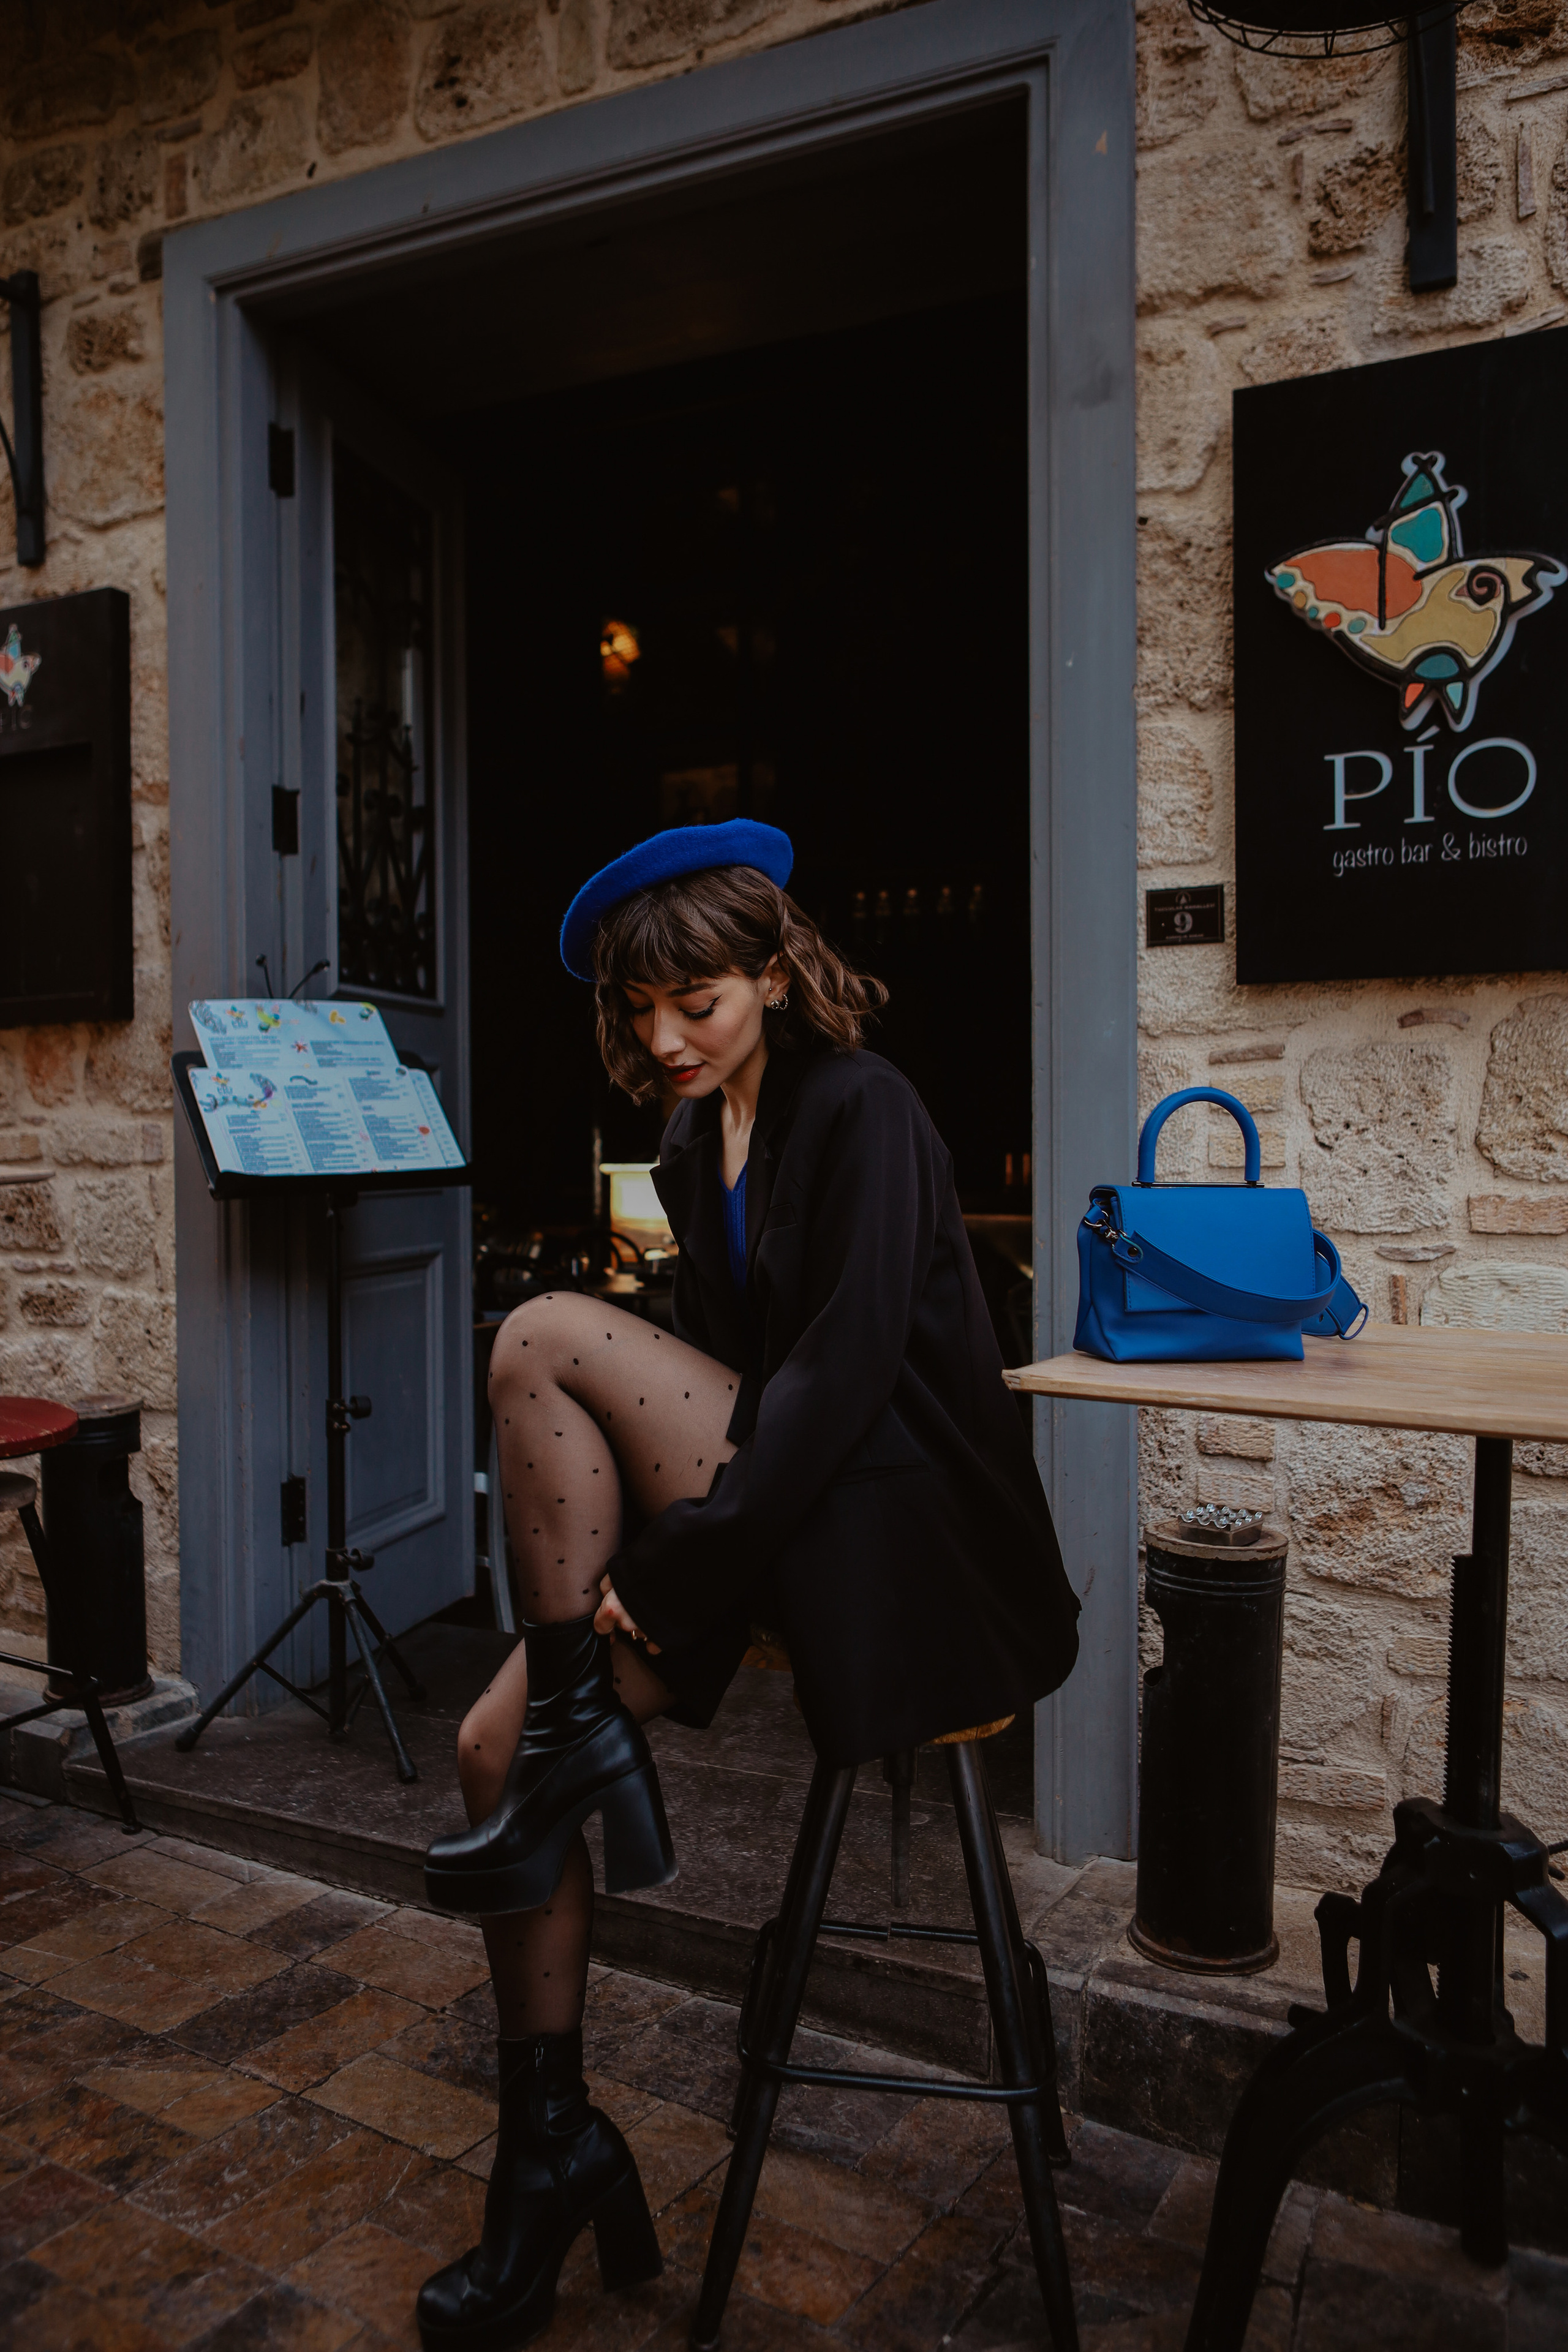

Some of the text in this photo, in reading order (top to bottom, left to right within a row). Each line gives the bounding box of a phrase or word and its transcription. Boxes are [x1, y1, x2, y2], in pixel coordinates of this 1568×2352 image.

[1324, 726, 1537, 830] PÍO
[1333, 832, 1528, 877] gastro bar & bistro
[1174, 911, 1193, 934] 9
